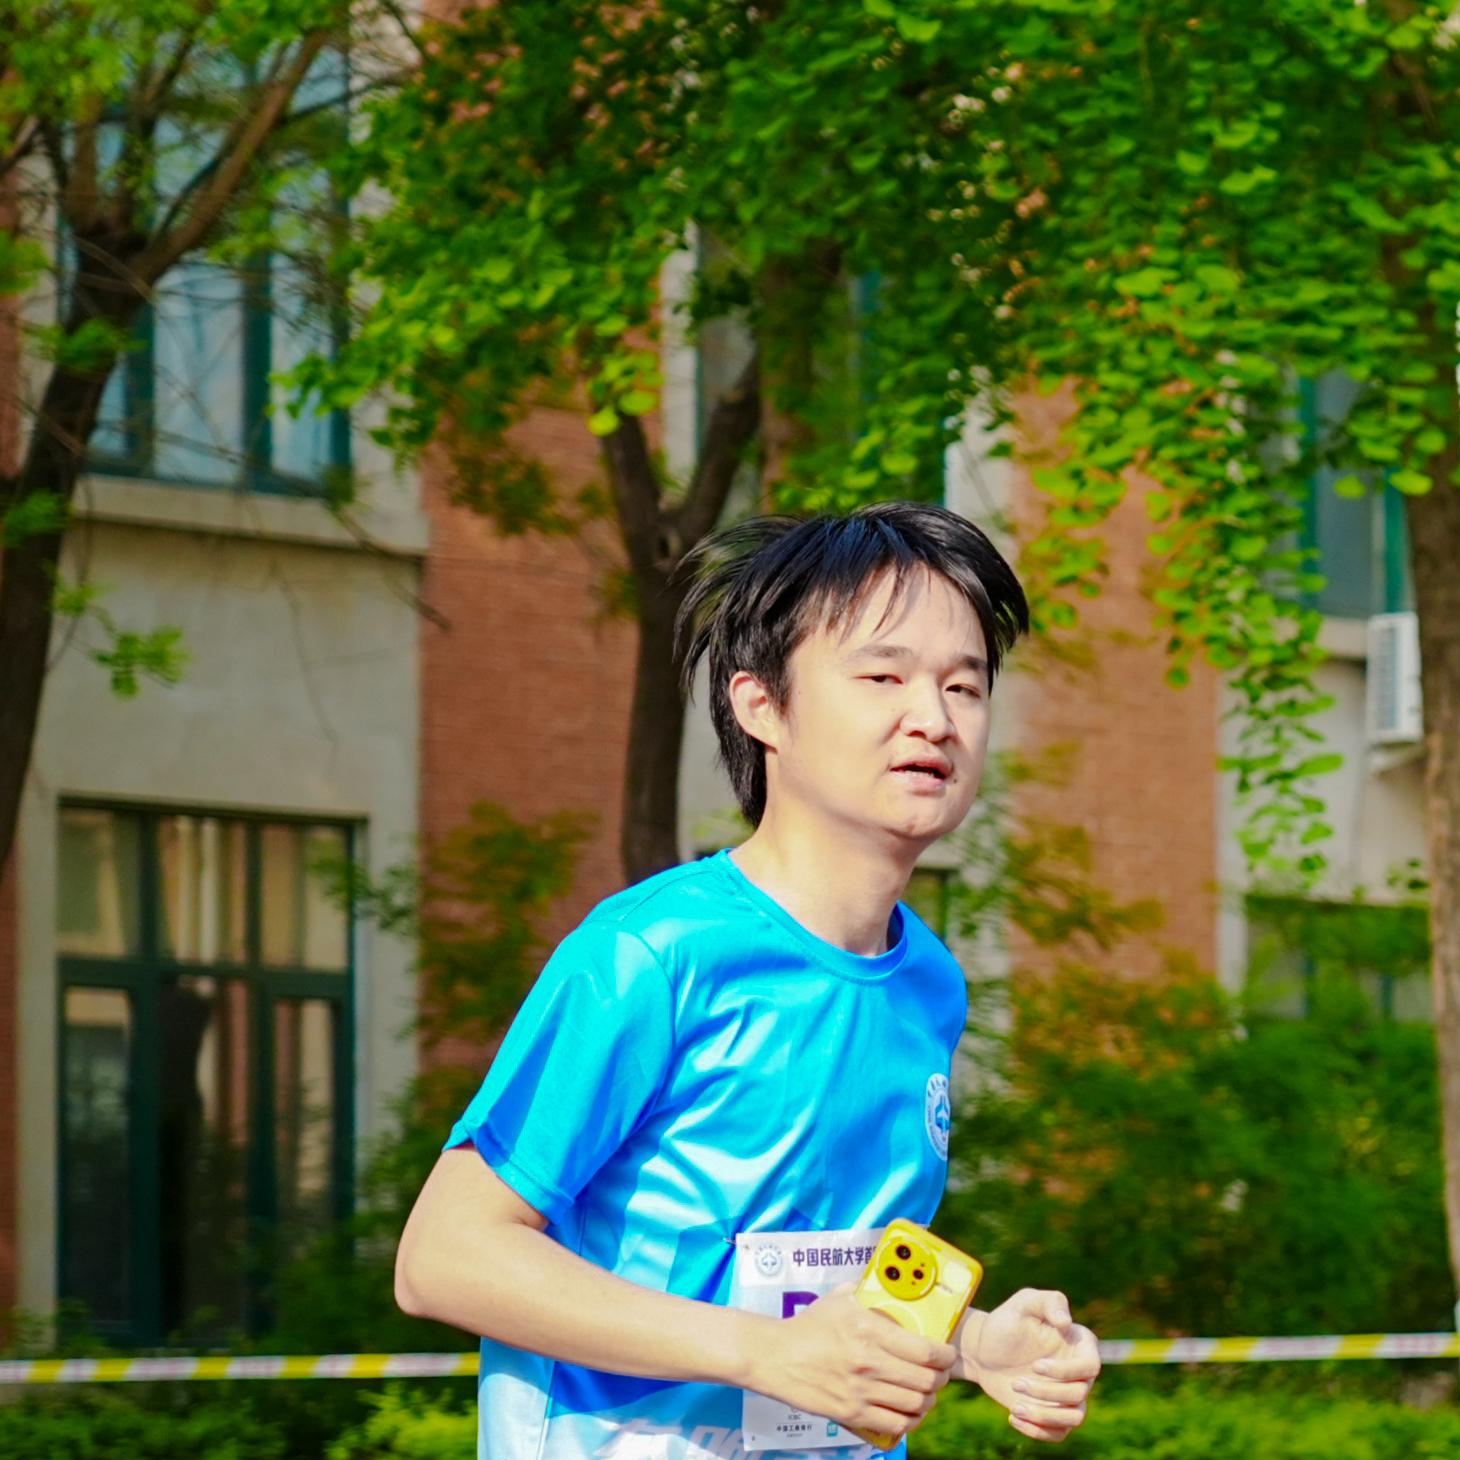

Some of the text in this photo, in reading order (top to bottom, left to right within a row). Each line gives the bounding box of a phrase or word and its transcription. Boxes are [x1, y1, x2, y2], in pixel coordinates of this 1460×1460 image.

[793, 1246, 877, 1267] 中国民航大学首
